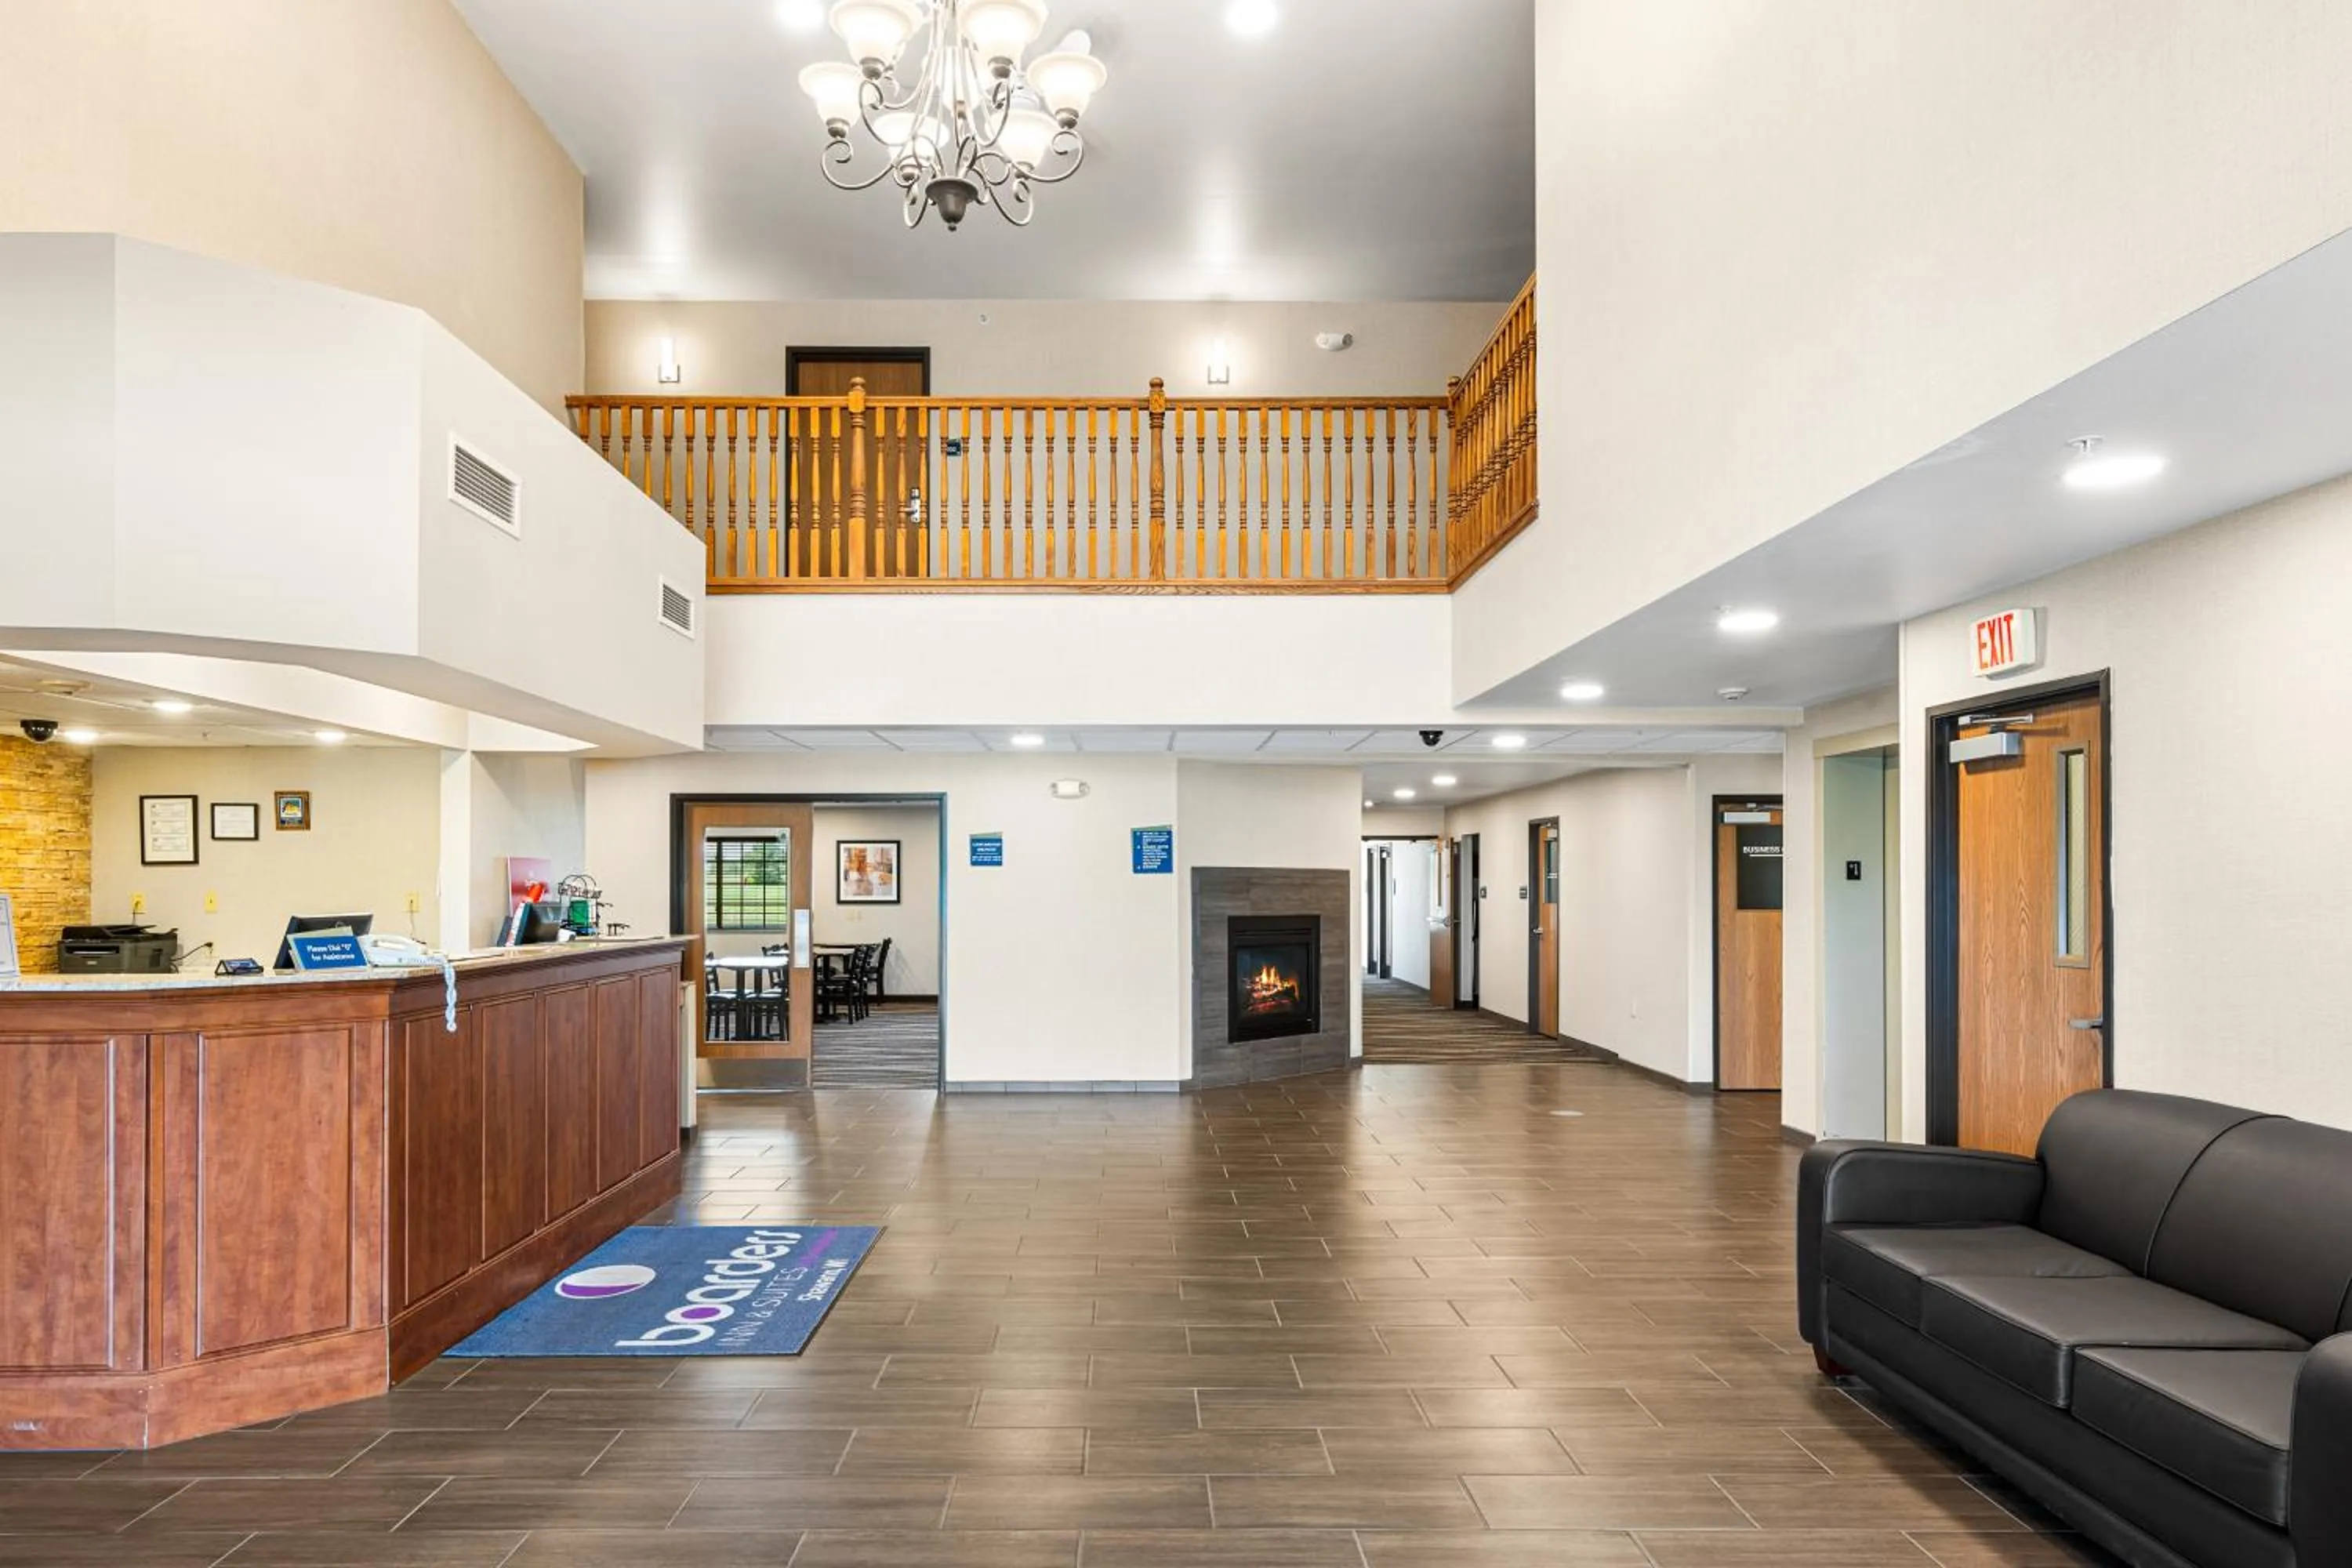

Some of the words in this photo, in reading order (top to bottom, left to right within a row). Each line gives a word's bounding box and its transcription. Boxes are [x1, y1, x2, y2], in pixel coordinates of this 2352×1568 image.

[1976, 614, 2014, 670] EXIT
[615, 1230, 801, 1346] boarders
[752, 1266, 808, 1308] SUITES
[715, 1322, 763, 1346] INN
[748, 1308, 773, 1318] &
